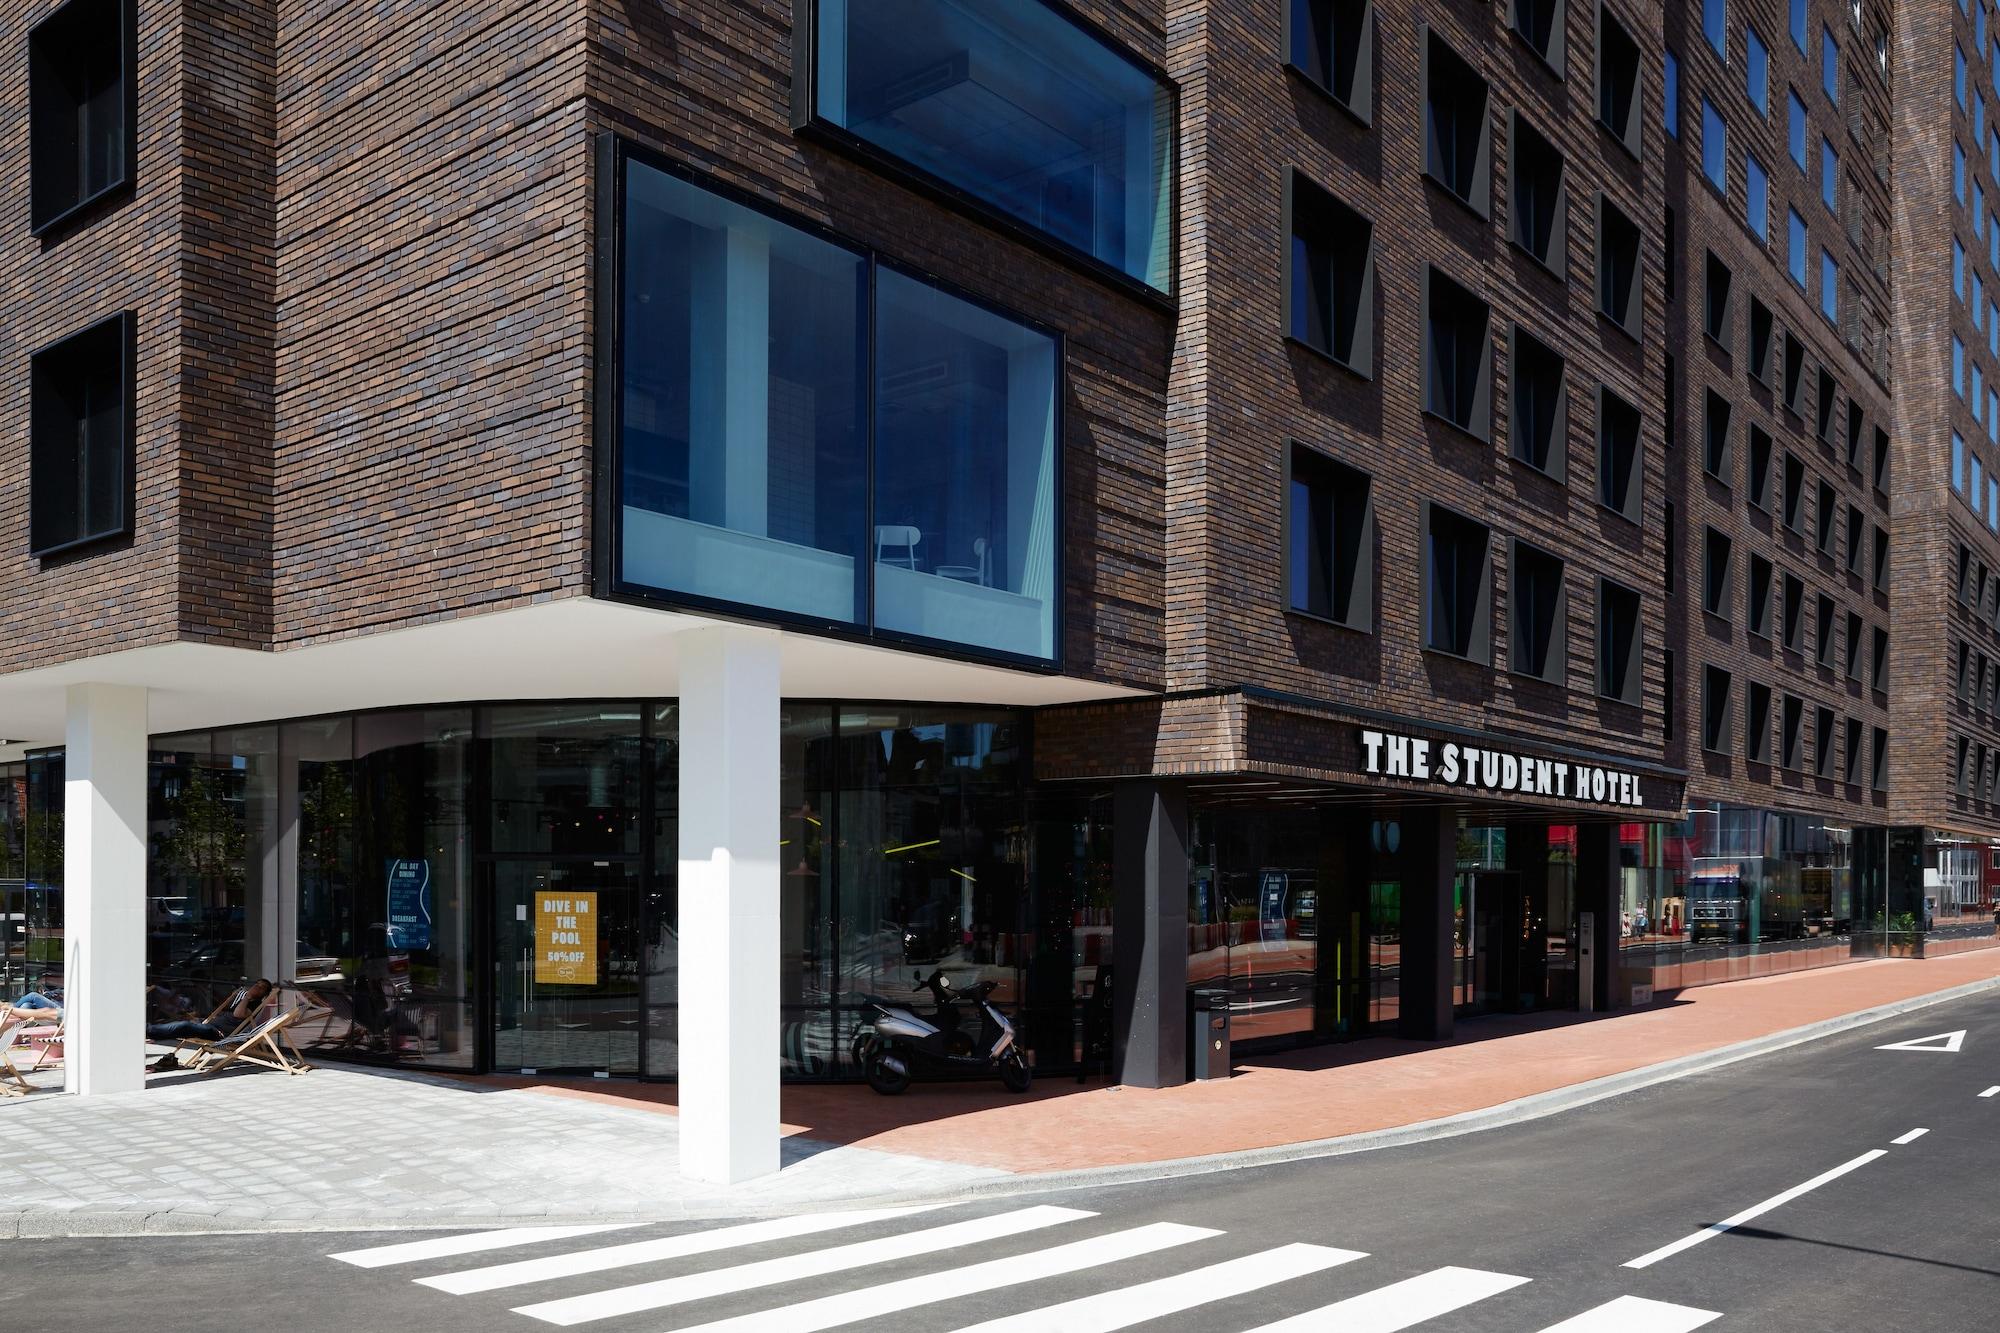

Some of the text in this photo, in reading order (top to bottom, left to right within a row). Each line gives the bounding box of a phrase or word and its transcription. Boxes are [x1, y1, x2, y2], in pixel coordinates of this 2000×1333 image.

[1362, 730, 1643, 806] THE STUDENT HOTEL
[544, 900, 589, 913] DIVE IN
[556, 916, 577, 929] THE
[551, 932, 581, 945] POOL
